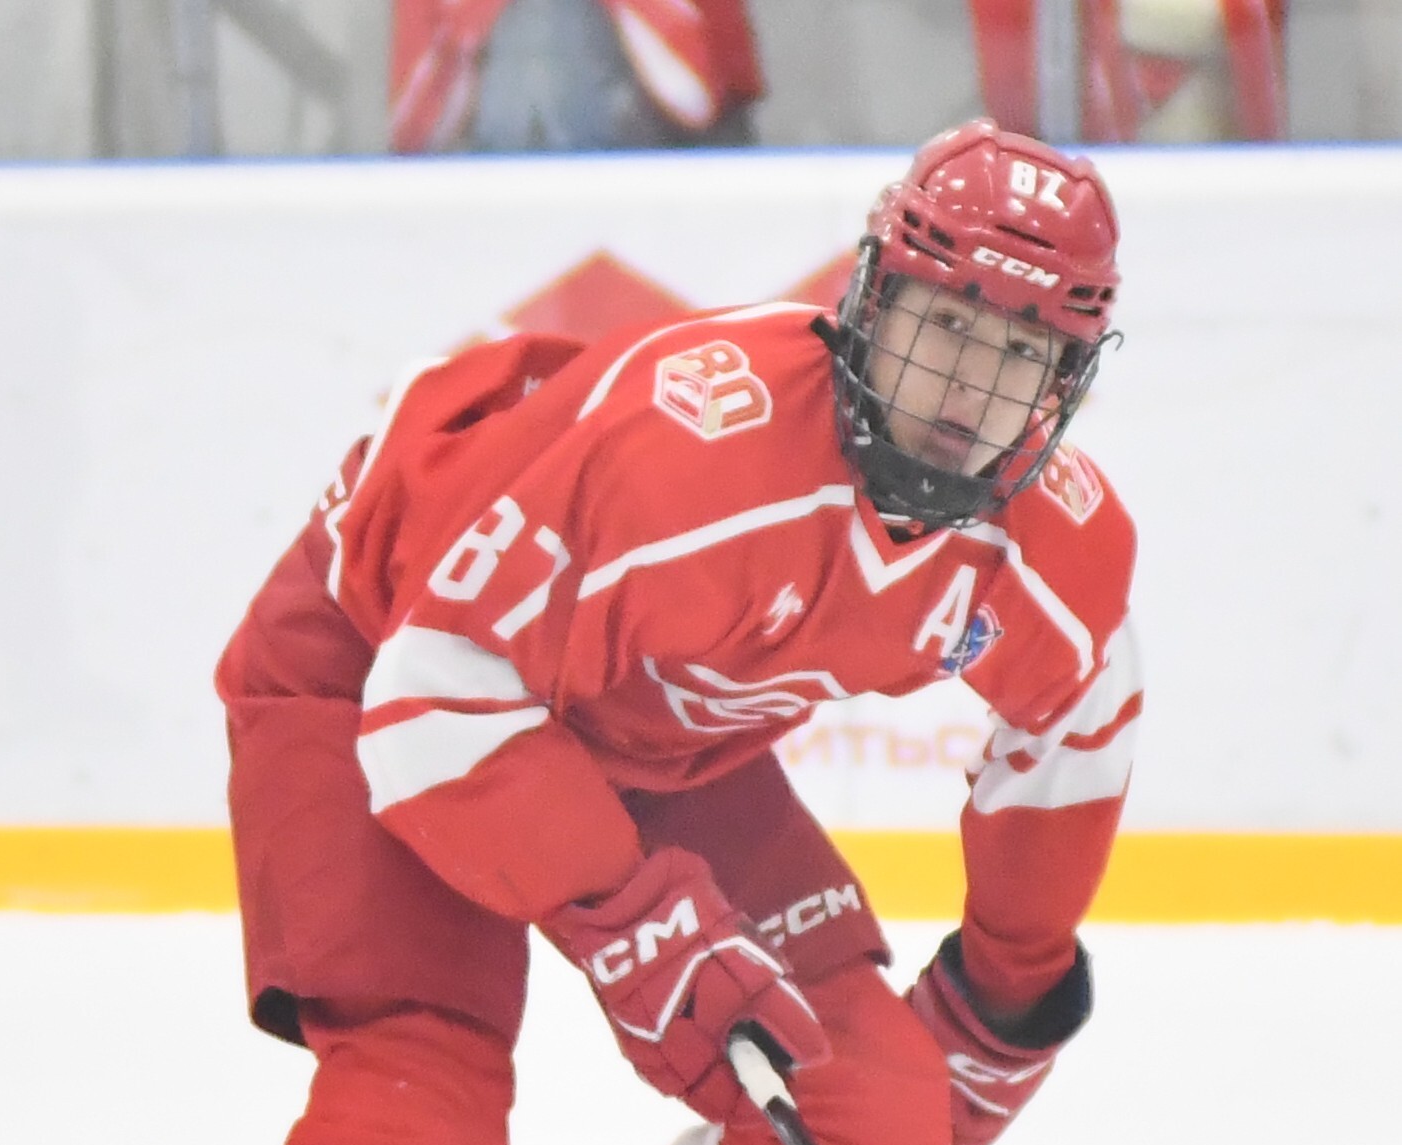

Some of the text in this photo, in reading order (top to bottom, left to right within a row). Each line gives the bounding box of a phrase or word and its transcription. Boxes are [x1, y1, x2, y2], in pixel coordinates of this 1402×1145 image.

[972, 246, 1061, 289] CCM
[427, 495, 571, 642] 87
[913, 564, 977, 658] A
[785, 724, 982, 770] ИТЬС
[592, 896, 699, 984] CM
